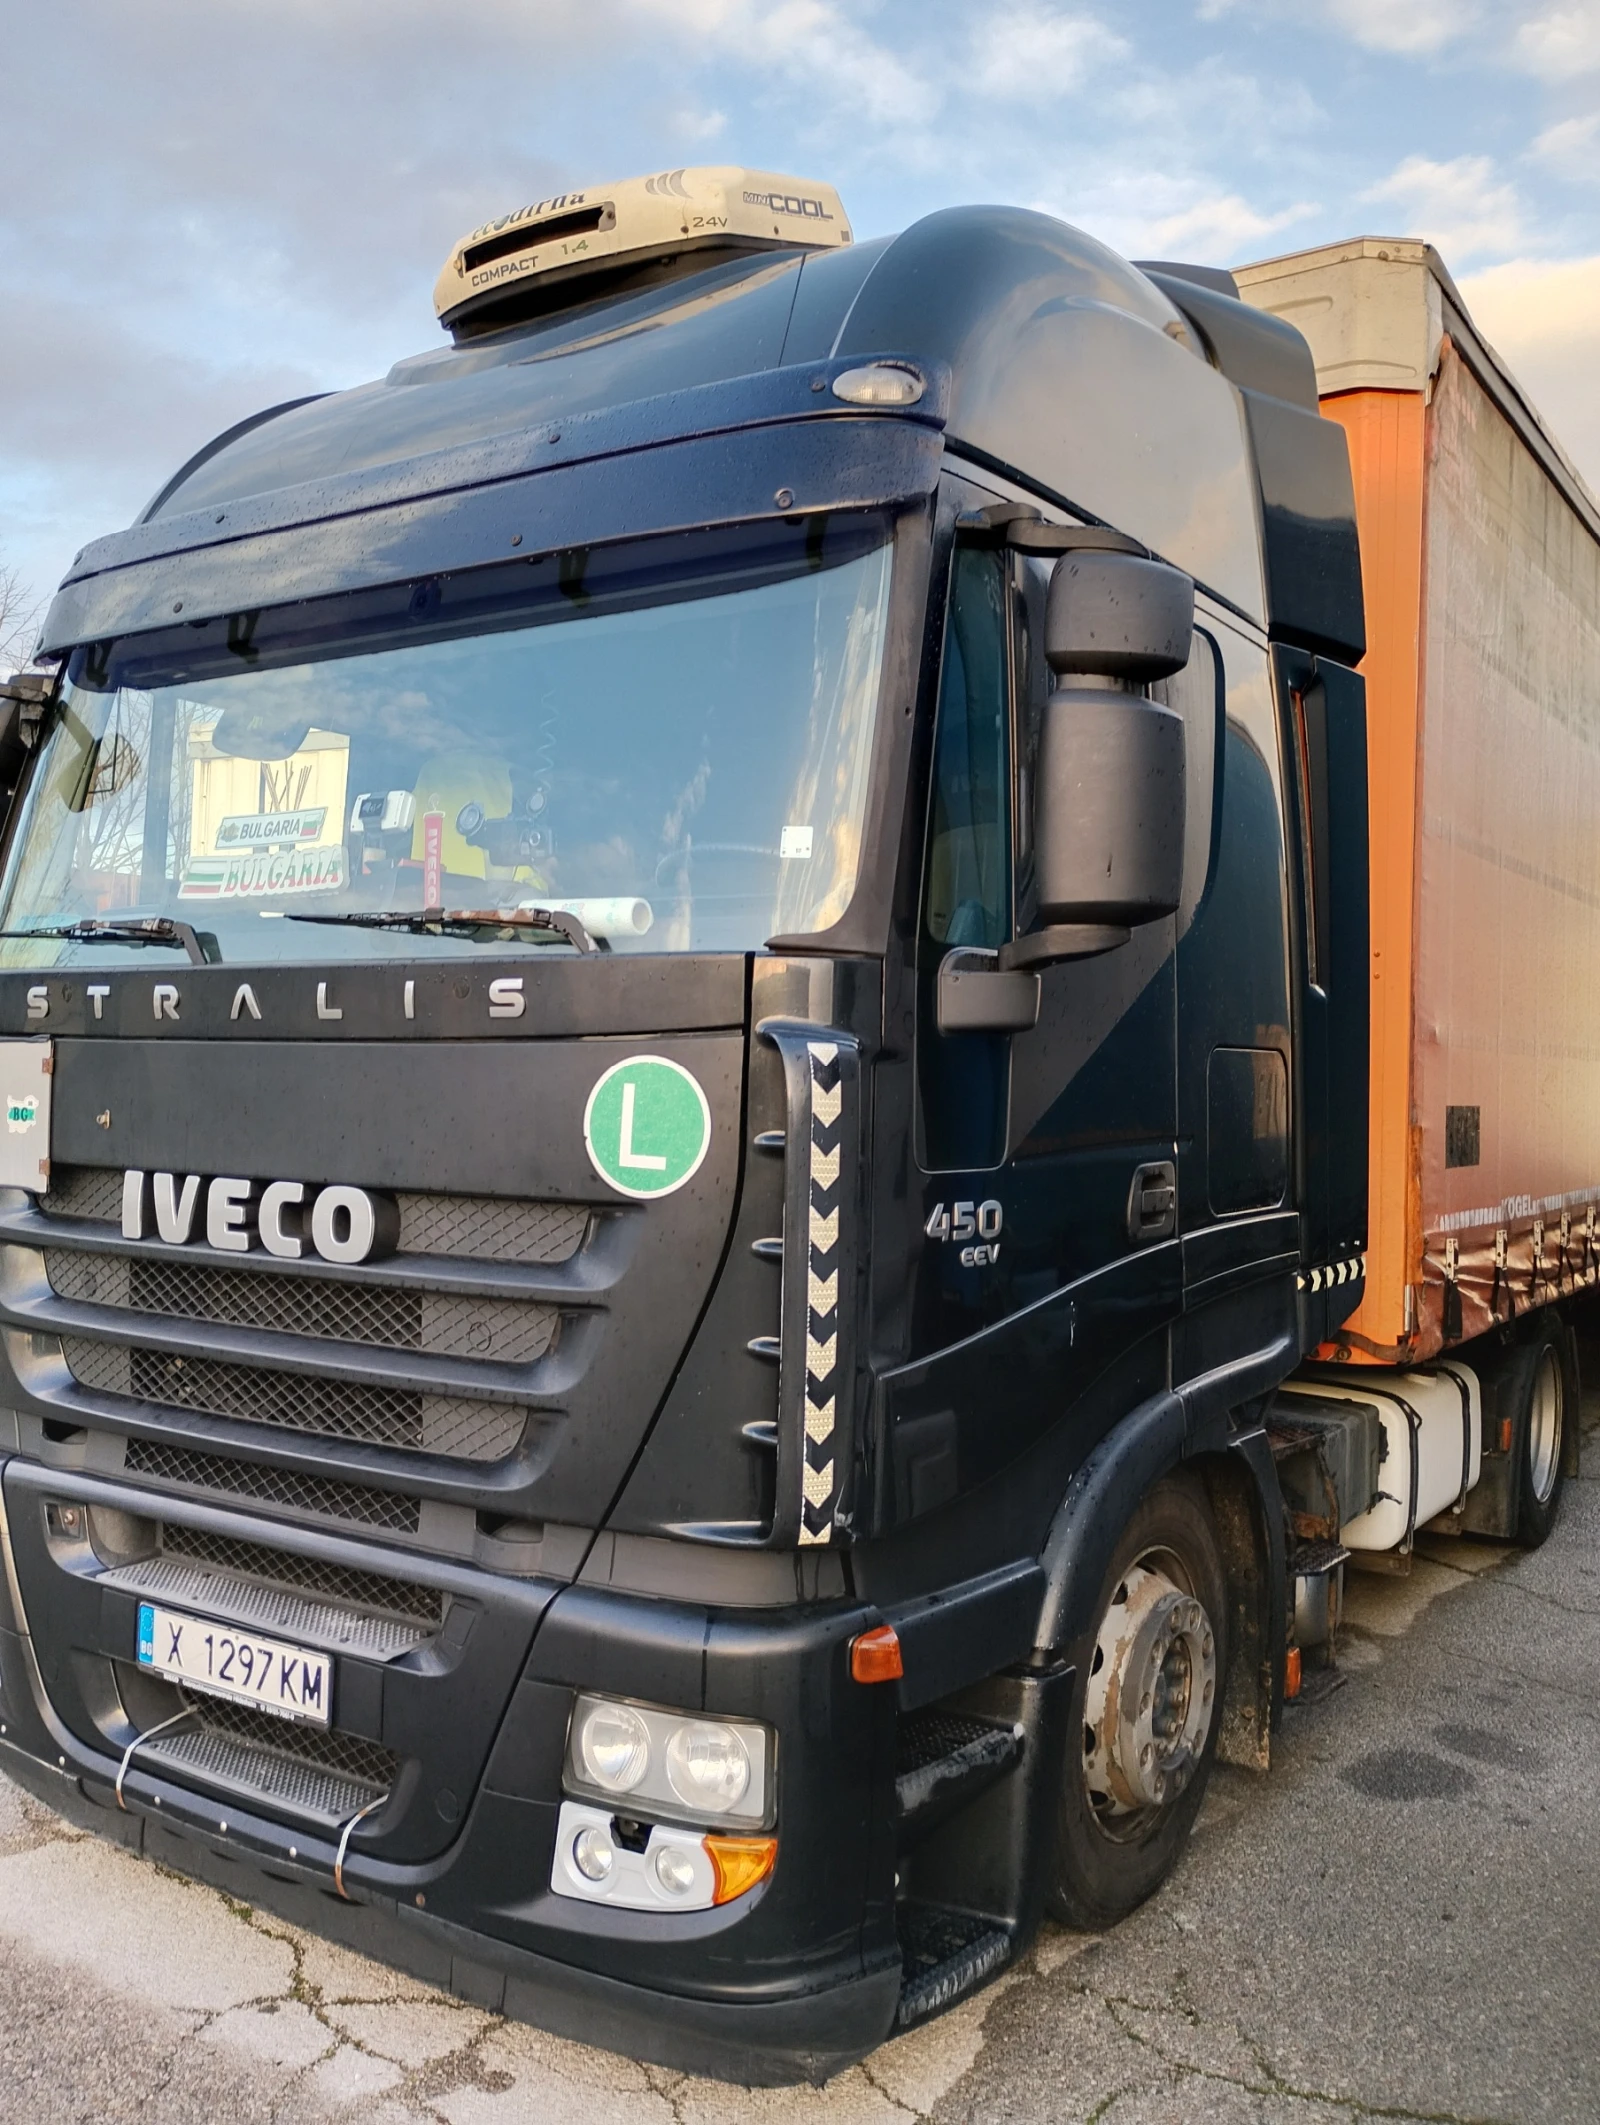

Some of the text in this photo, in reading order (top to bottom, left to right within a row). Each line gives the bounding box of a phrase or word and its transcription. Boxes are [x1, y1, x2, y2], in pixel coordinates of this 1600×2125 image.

[693, 216, 728, 229] 24V
[472, 240, 588, 287] COMPACT 1.4
[240, 818, 300, 839] BULGARIA
[224, 849, 339, 892] BULGARIA
[427, 828, 438, 905] IVECO
[27, 977, 526, 1020] STRALIS
[13, 1106, 28, 1122] BG
[619, 1082, 667, 1170] L
[121, 1170, 375, 1264] IVECO
[924, 1199, 1003, 1242] 450
[960, 1243, 1000, 1268] EEV
[168, 1621, 184, 1668] X
[204, 1634, 274, 1692] 1297
[280, 1654, 322, 1710] KM
